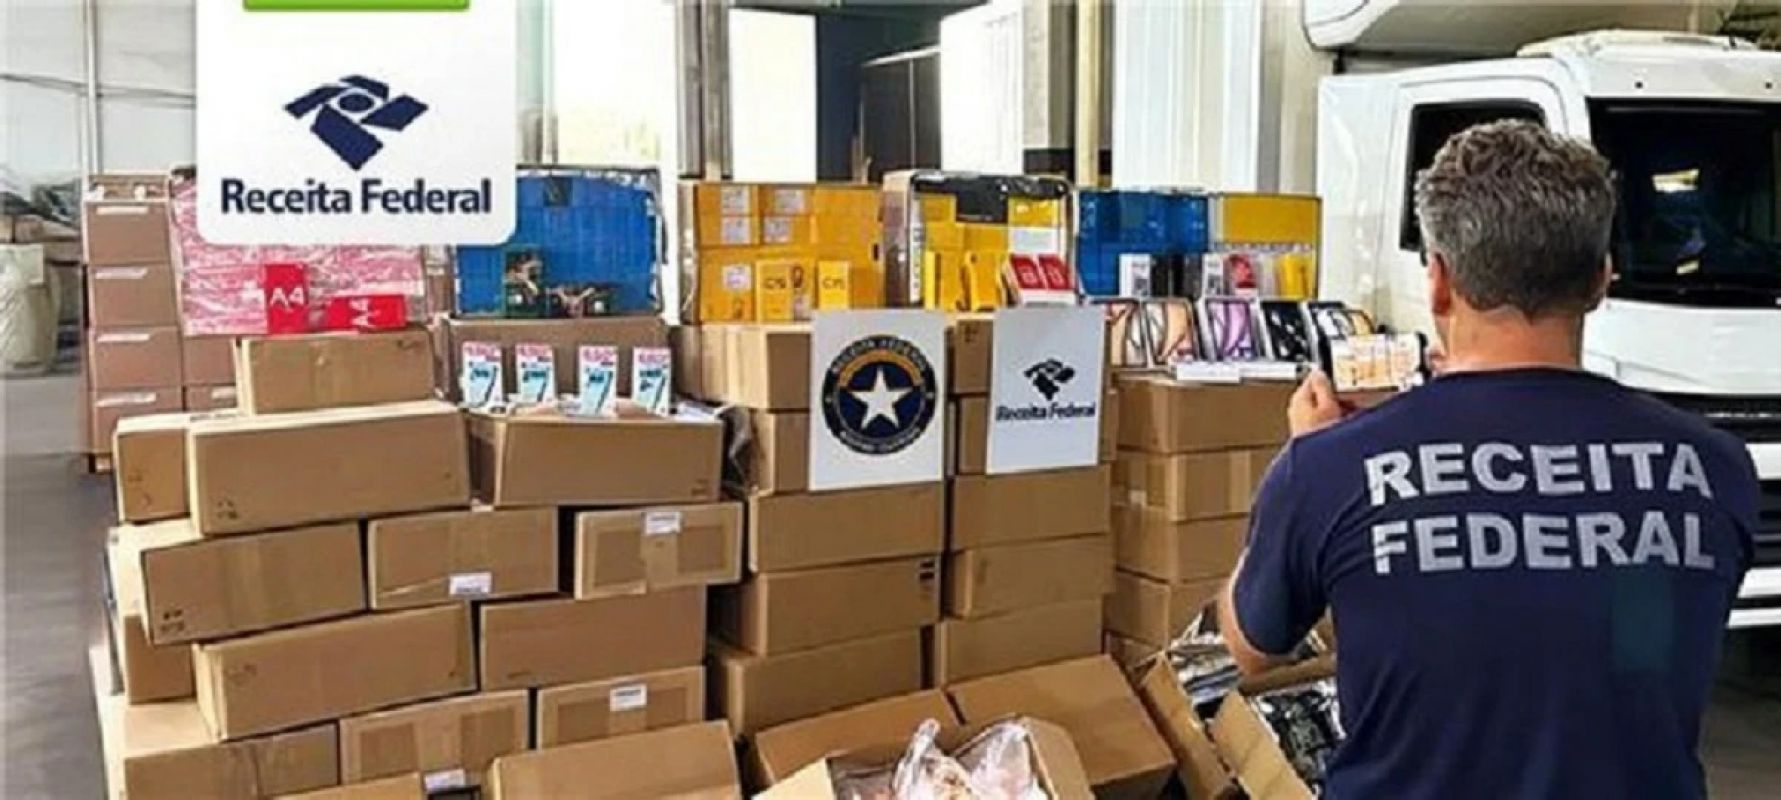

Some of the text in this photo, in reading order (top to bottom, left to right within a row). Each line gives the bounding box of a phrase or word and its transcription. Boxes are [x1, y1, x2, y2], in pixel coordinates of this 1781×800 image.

[269, 286, 305, 308] A4
[1048, 401, 1096, 419] Federal
[1364, 443, 1714, 506] RECEITA
[1372, 510, 1716, 575] FEDERAL
